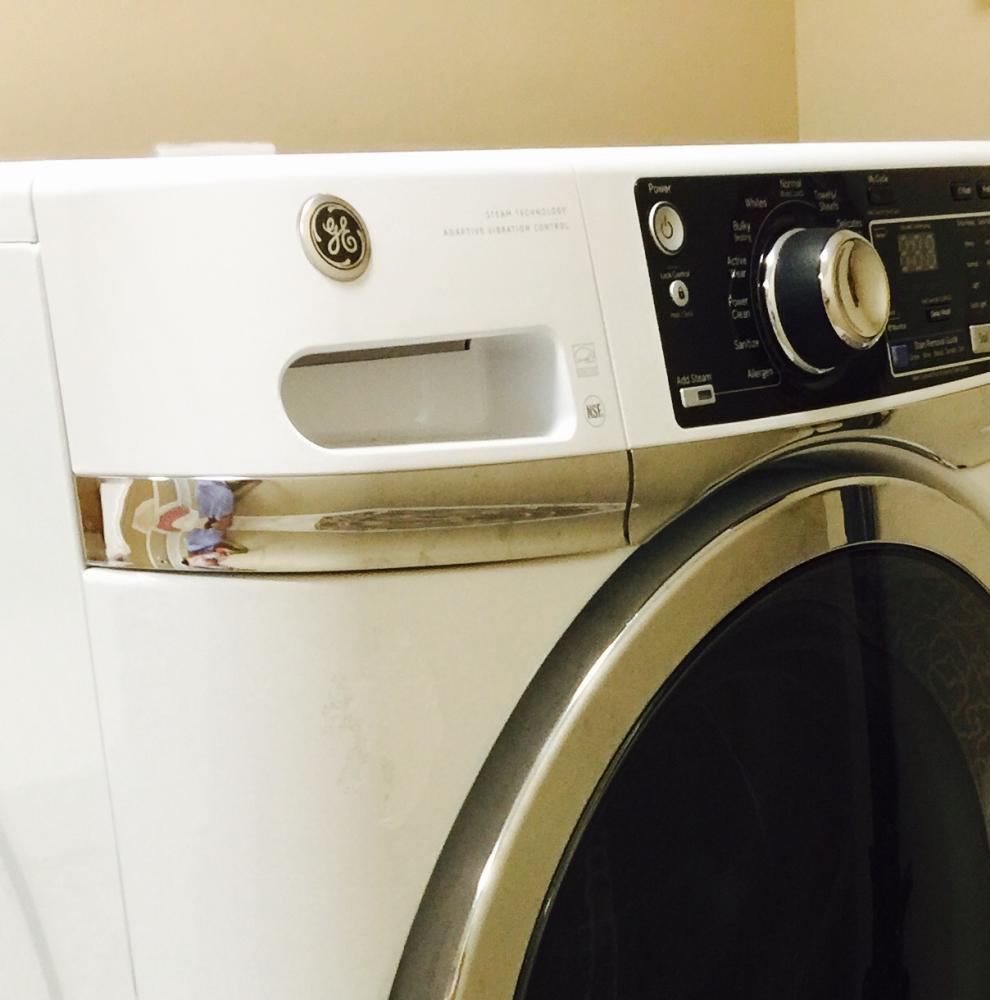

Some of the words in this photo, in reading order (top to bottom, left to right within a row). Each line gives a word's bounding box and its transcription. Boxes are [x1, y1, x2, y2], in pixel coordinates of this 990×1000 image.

[647, 182, 672, 195] Power
[485, 209, 511, 219] STEAM
[515, 207, 567, 217] TECHNOLOGY
[443, 226, 485, 237] ADAPTIVE
[487, 224, 531, 235] VIBRATION
[534, 222, 570, 232] CONTROL
[676, 375, 690, 385] Add
[690, 373, 713, 384] Steam
